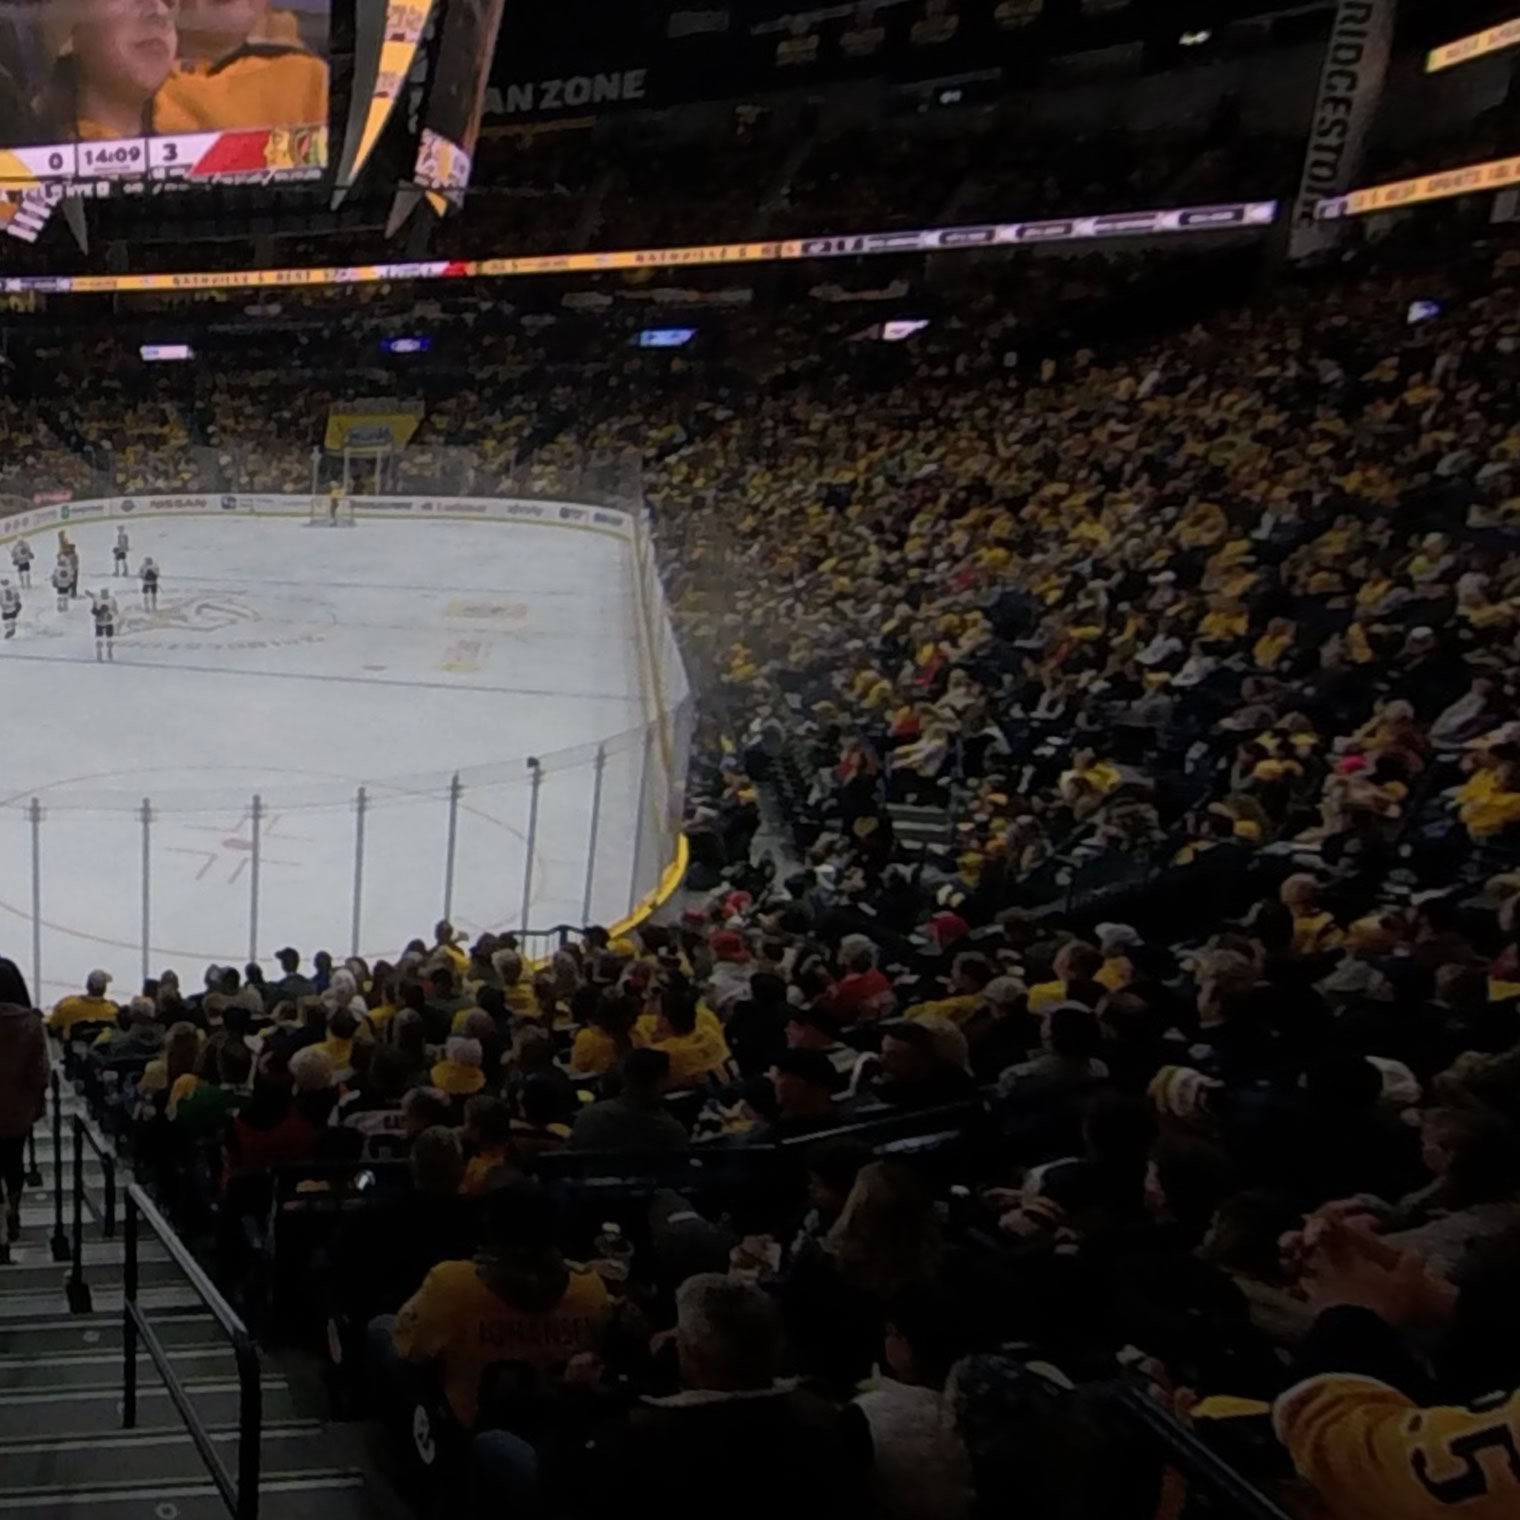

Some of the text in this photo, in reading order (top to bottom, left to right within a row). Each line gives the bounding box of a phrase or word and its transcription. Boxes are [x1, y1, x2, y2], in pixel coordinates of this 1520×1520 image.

[482, 67, 648, 114] AN ZONE
[48, 138, 178, 171] 0 14:09 3
